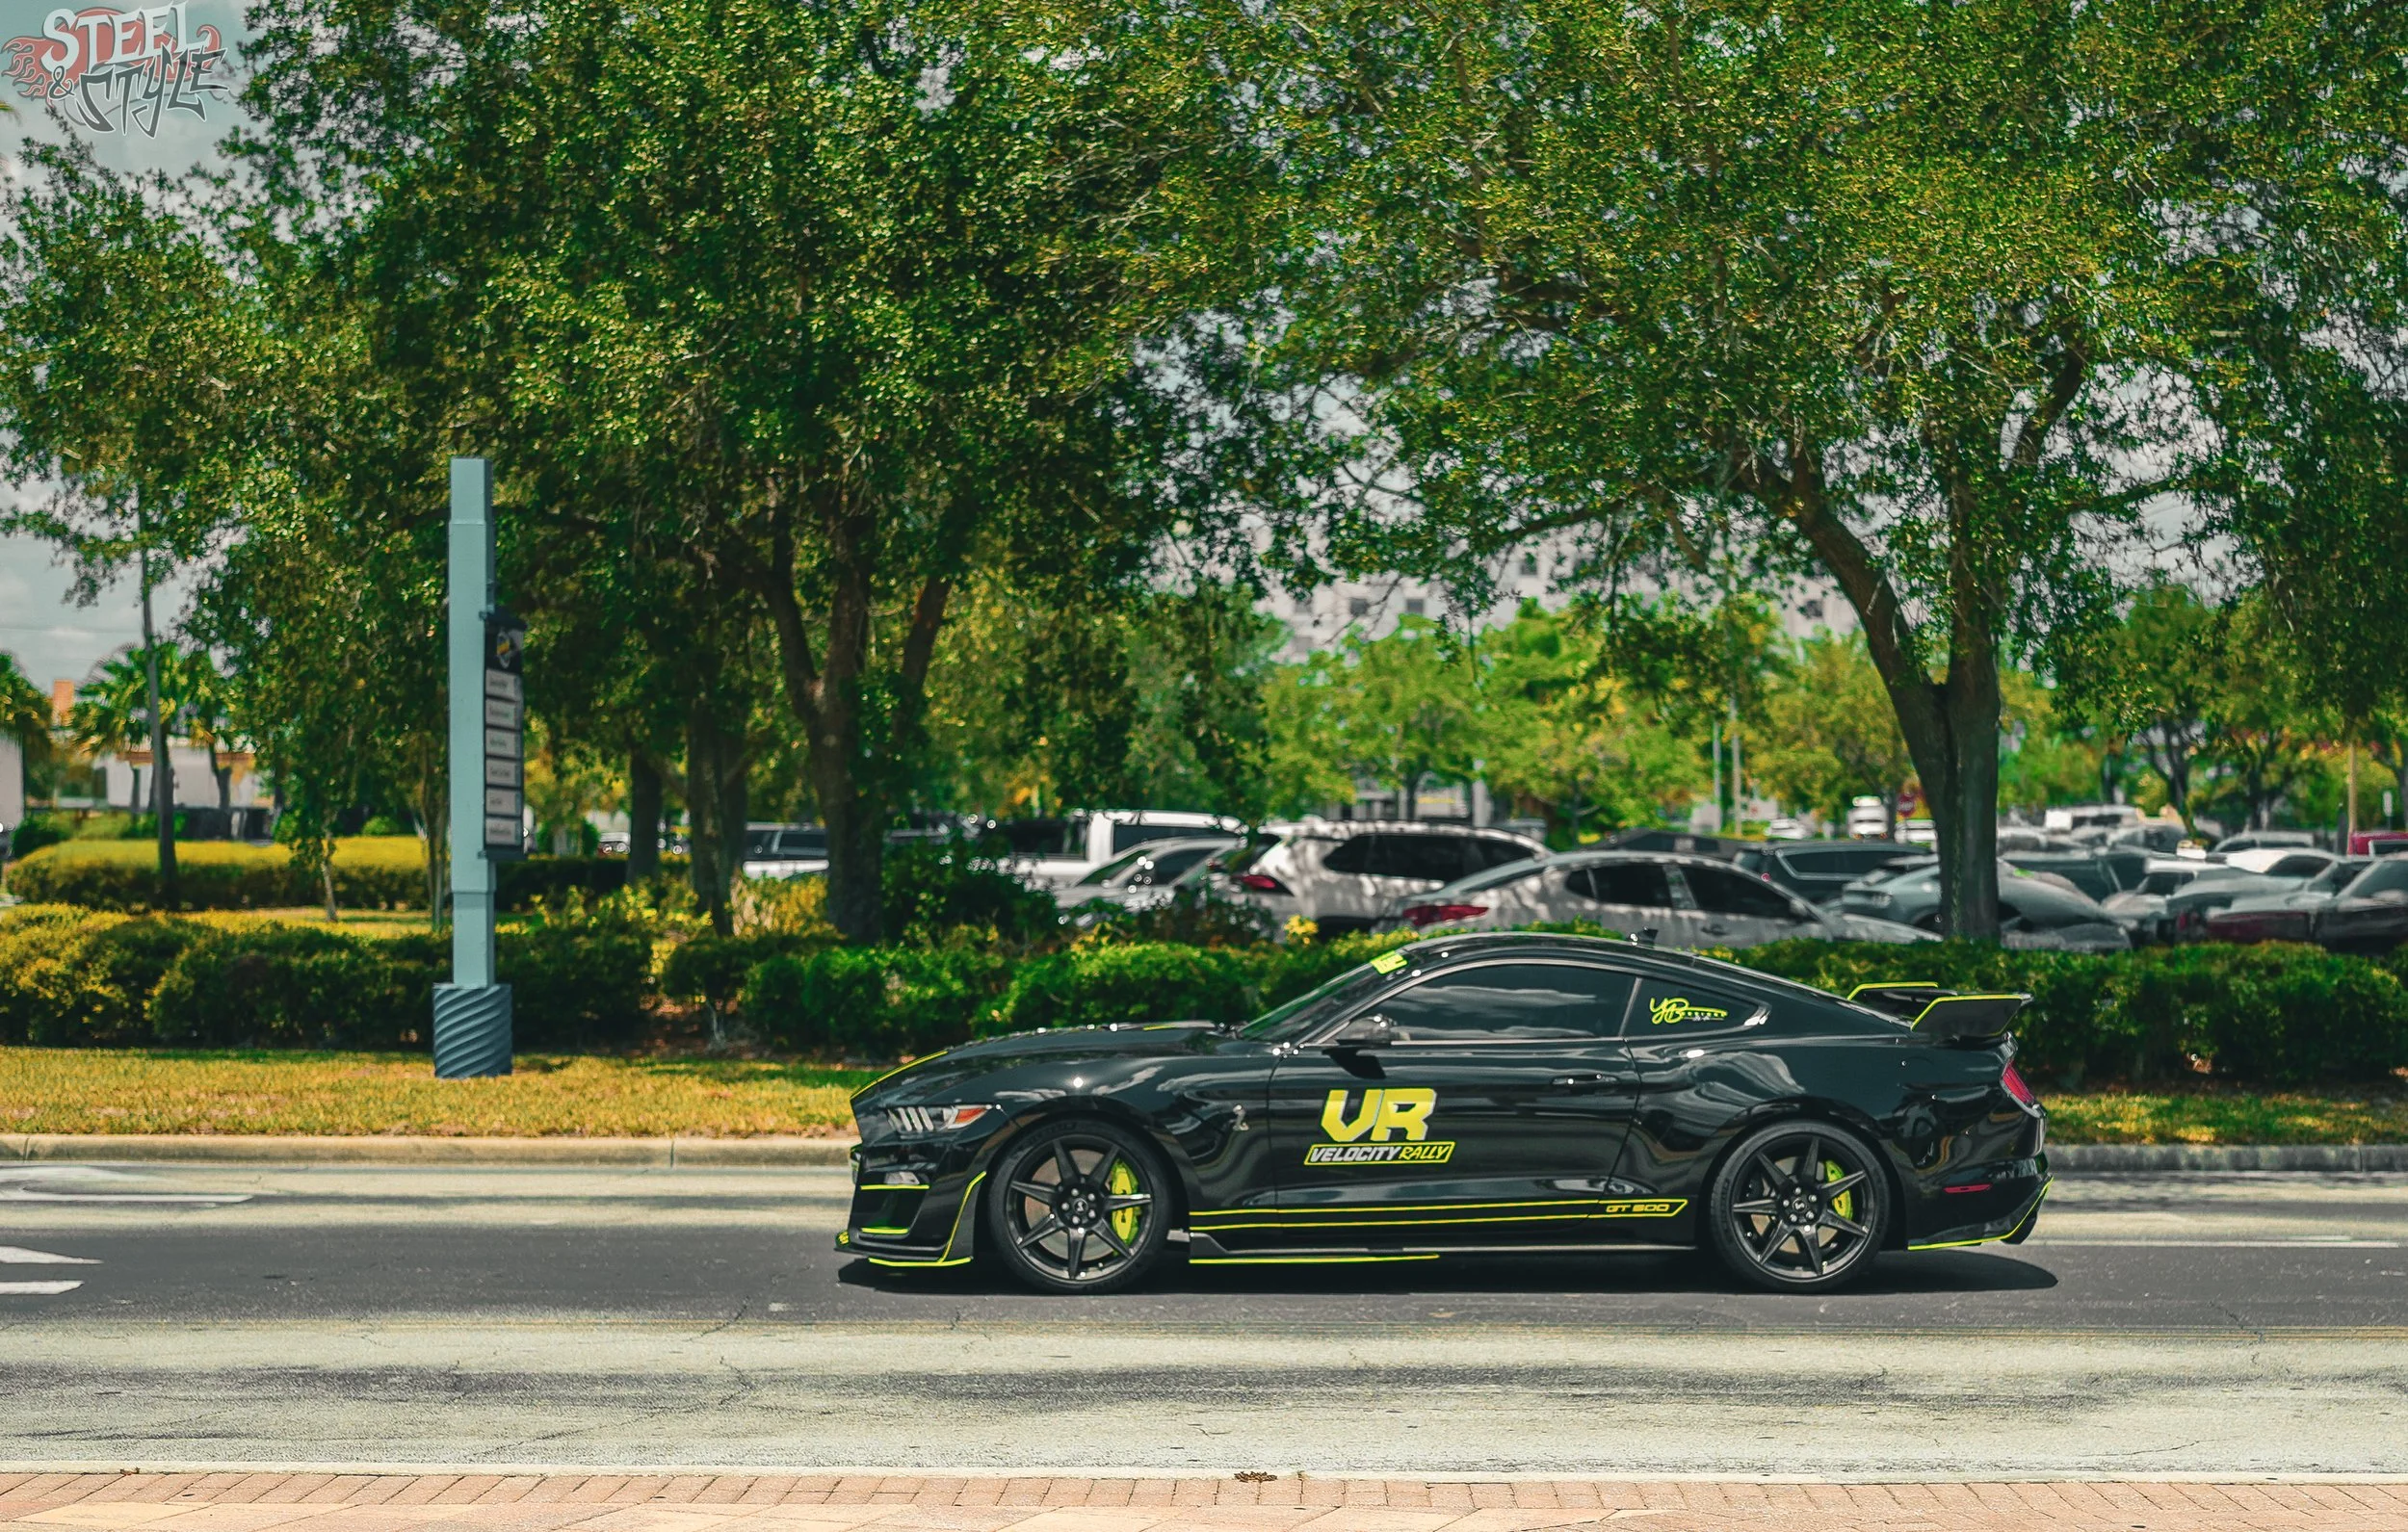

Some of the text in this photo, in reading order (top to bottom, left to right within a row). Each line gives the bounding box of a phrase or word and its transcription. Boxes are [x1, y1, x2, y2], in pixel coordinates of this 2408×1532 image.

[1309, 1145, 1450, 1162] VELOCITY RALLY
[1606, 1205, 1632, 1213] GT
